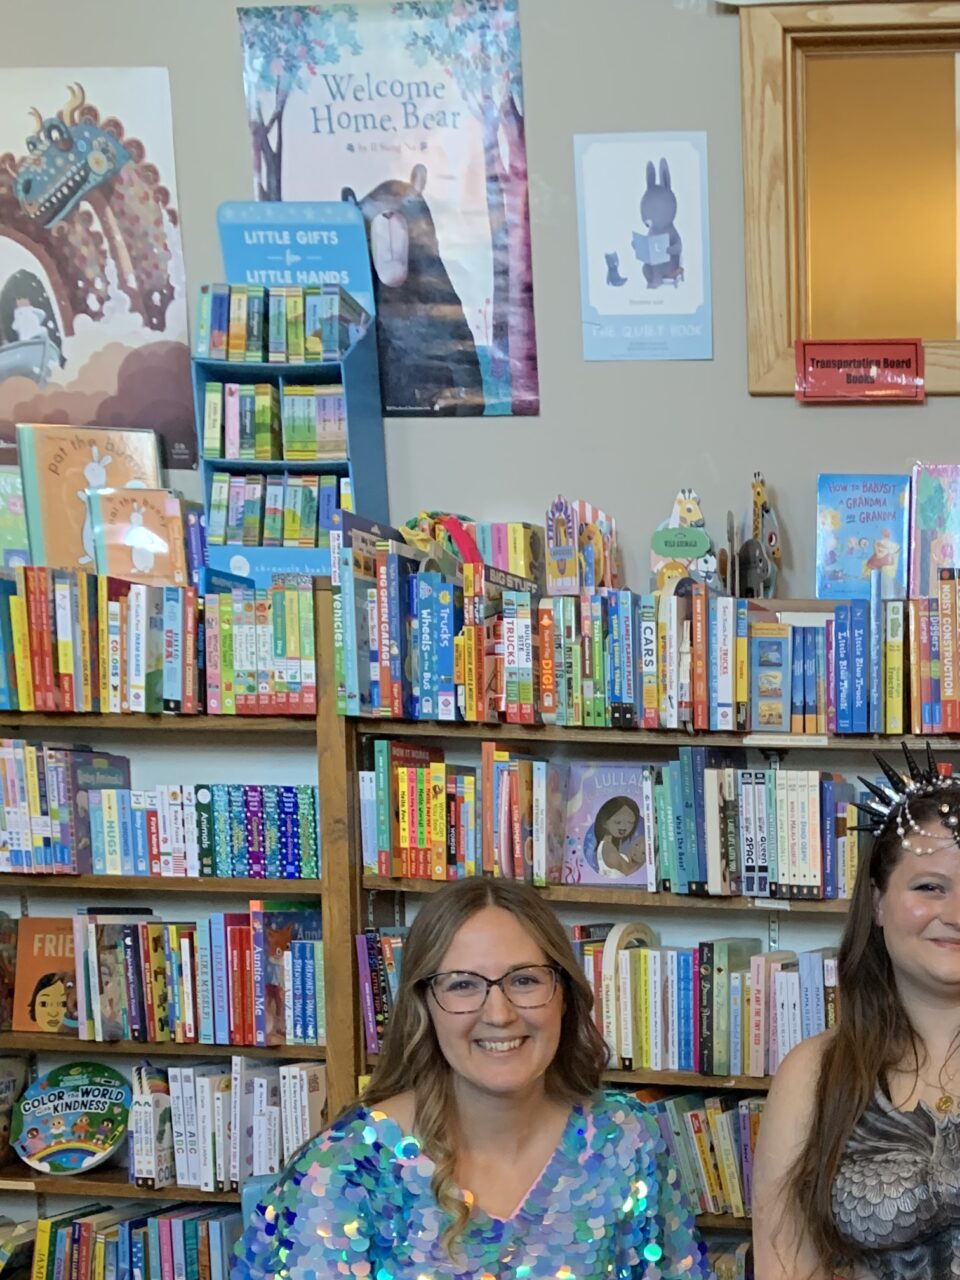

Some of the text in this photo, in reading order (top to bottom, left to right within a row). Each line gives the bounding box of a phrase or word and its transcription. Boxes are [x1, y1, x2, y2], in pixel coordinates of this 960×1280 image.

[320, 72, 446, 102] Welcome
[310, 101, 460, 134] Home, Bear
[244, 230, 339, 246] LITTLE GIFTS
[246, 269, 350, 285] LITTLE HANDS
[333, 594, 346, 648] Vehicles
[439, 608, 452, 648] Trucks
[506, 620, 516, 666] TRUCKS
[644, 626, 654, 668] CARS
[943, 584, 953, 697] NOISY CONSTRUCTION
[111, 639, 120, 678] COLORS
[542, 660, 553, 689] DIG!
[854, 628, 864, 708] Little Blue Truck
[200, 811, 210, 849] Animals
[745, 837, 754, 864] 2PAC
[22, 1086, 125, 1113] COLOR WORLD
[52, 1100, 108, 1114] KINDNESS
